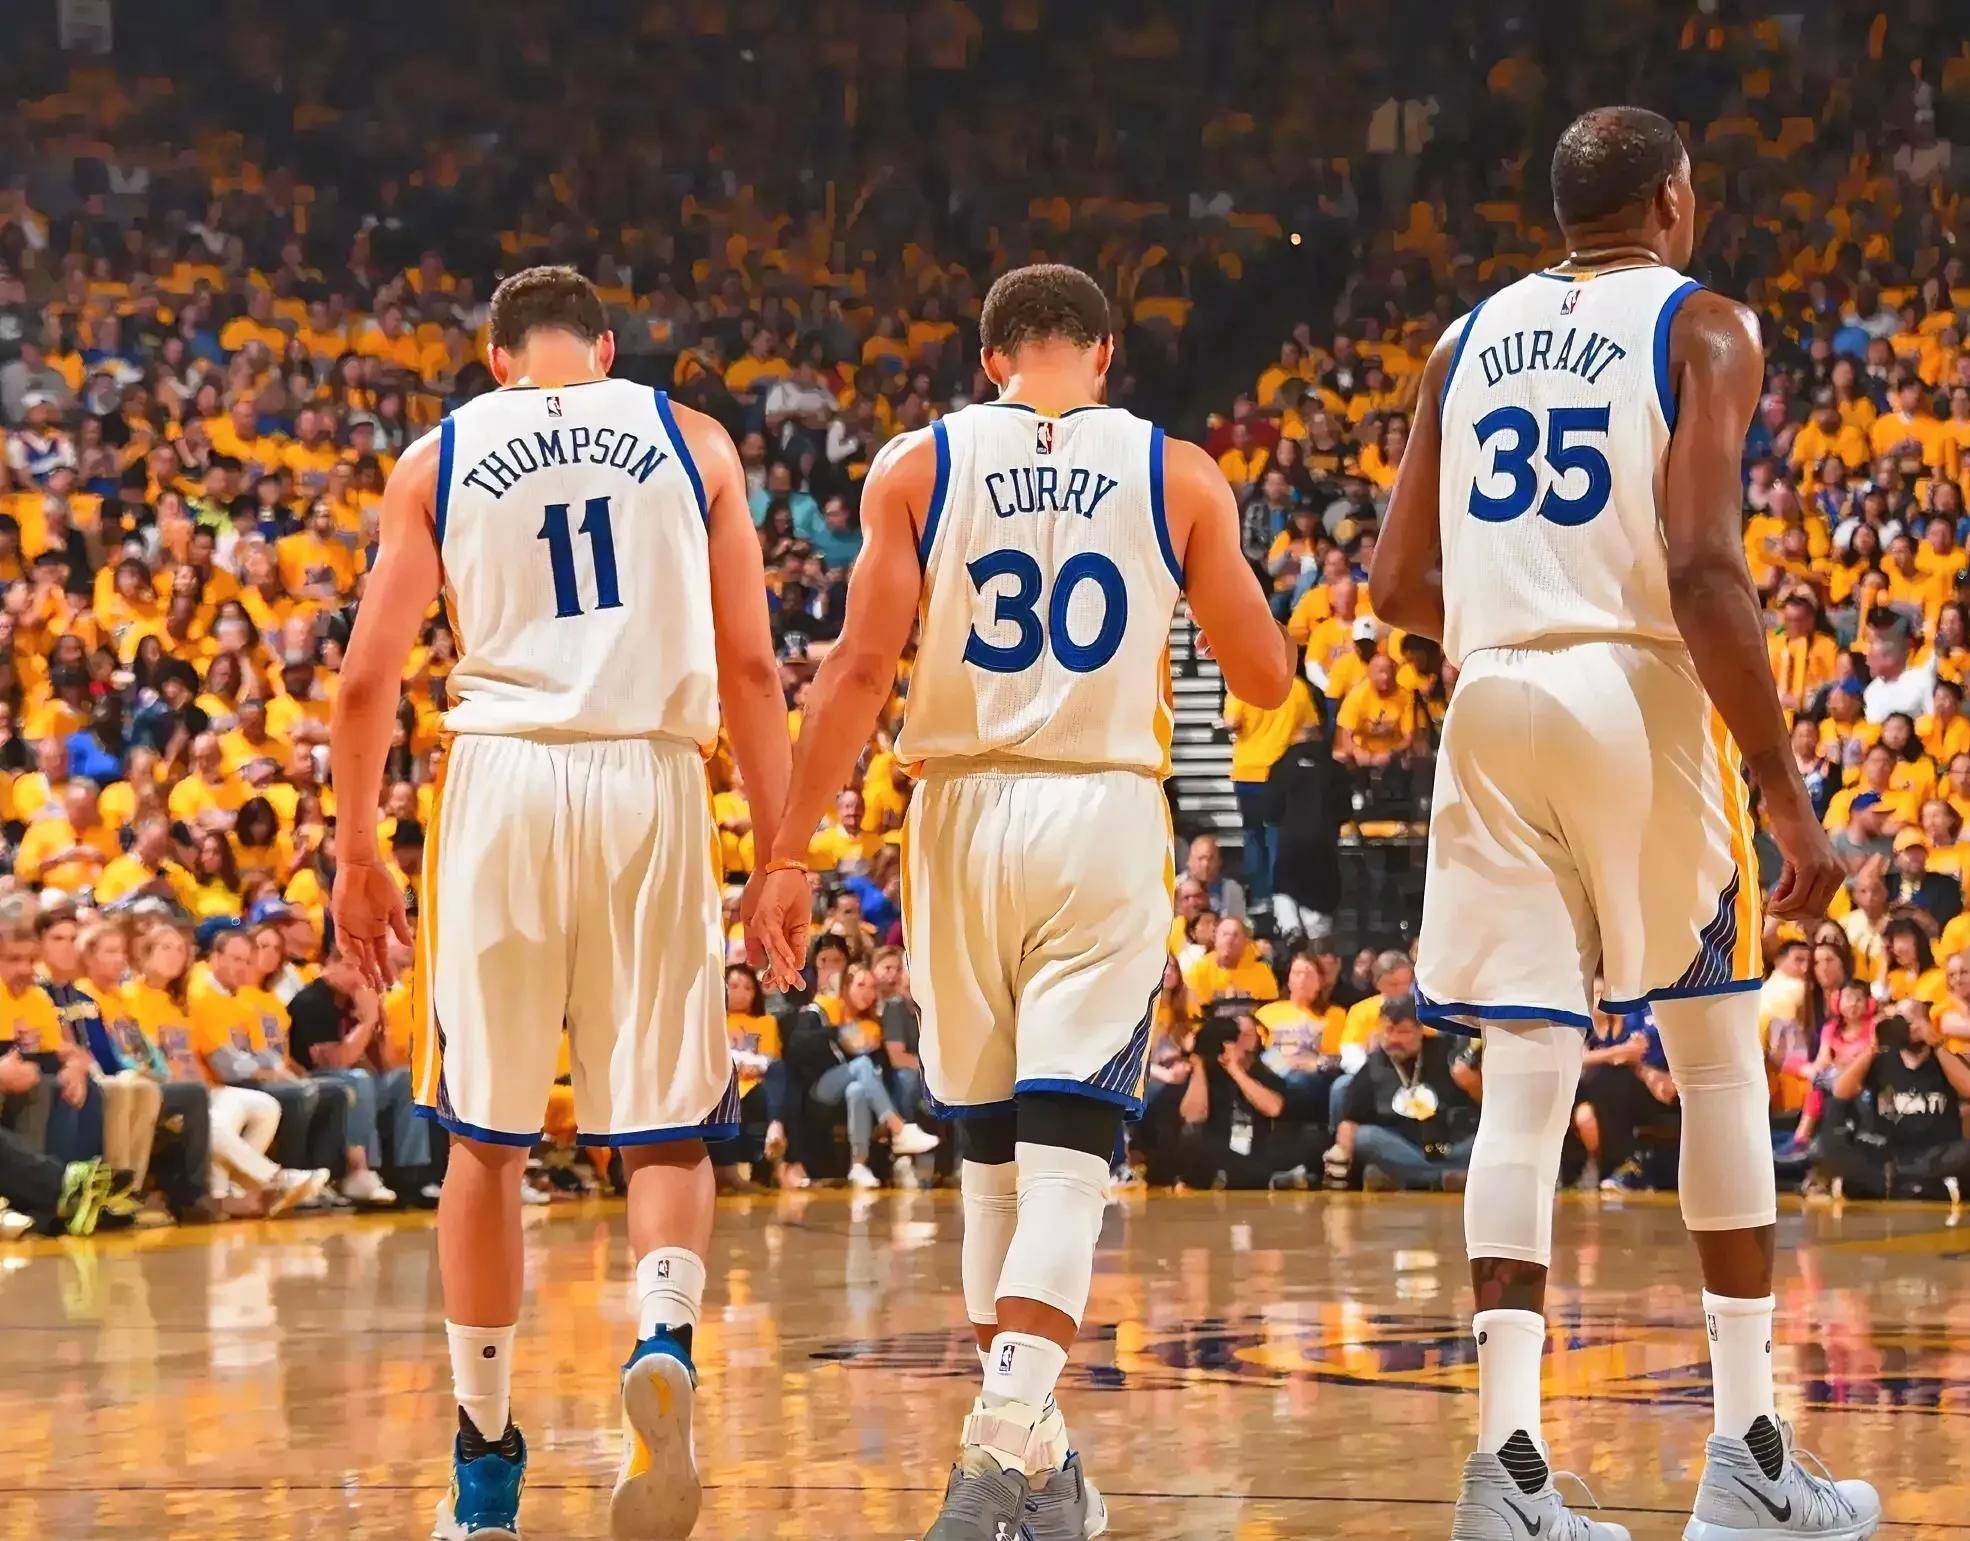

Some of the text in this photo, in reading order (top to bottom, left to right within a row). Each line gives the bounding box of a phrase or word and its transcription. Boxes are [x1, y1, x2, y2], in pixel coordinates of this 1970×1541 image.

[1479, 328, 1627, 387] DURANT
[463, 427, 668, 500] THOMPSON
[985, 467, 1118, 519] CURRY
[1467, 402, 1613, 526] 35
[536, 496, 624, 618] 11
[962, 549, 1128, 673] 30
